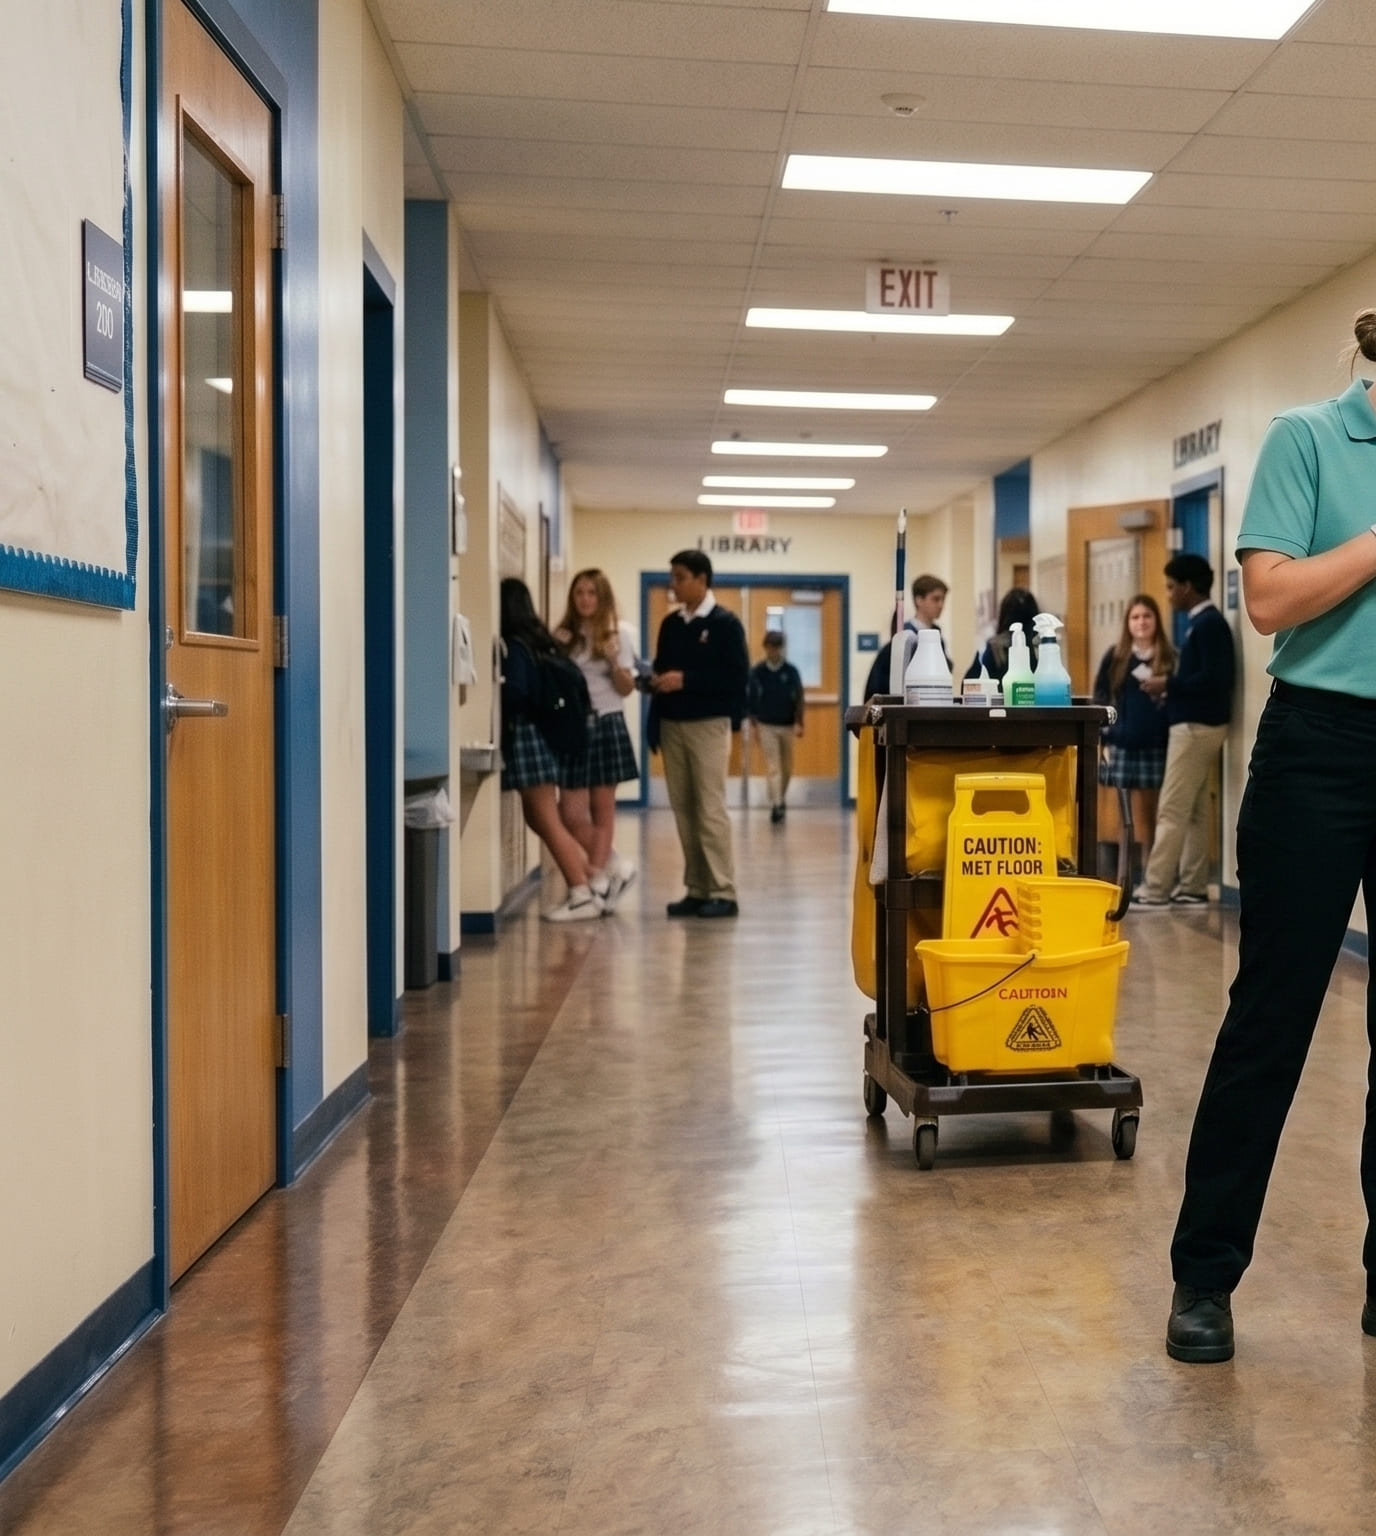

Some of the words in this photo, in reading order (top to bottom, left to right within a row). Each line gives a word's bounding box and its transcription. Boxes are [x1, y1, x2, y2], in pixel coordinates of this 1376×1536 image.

[880, 269, 938, 309] EXIT
[96, 301, 114, 339] 200
[697, 535, 793, 554] LIBRARY
[963, 837, 1042, 855] CAUTION:
[962, 860, 992, 875] MET
[997, 860, 1043, 875] FLOOR
